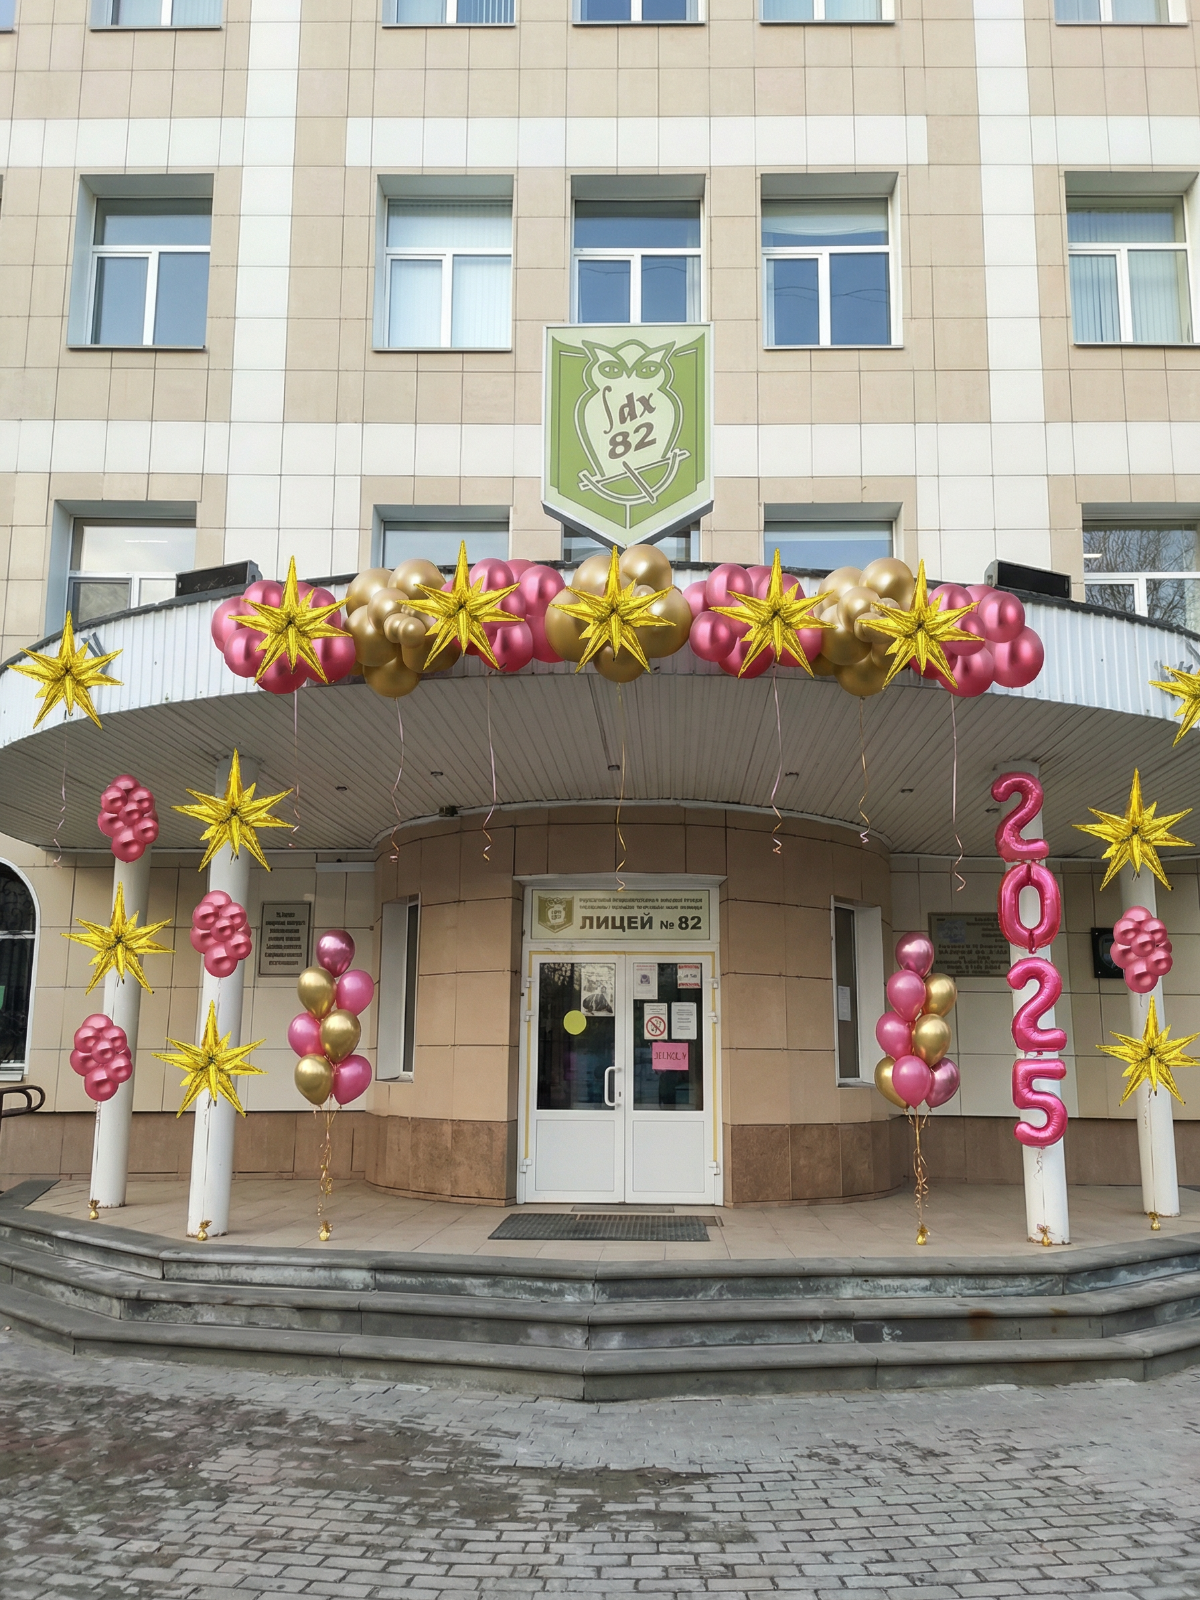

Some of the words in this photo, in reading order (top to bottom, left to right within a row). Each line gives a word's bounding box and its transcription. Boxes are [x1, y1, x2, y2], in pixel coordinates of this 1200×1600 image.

[608, 422, 657, 460] 82
[580, 912, 653, 932] ЛИЦЕЙ
[678, 915, 702, 930] 82
[991, 772, 1068, 1147] 2025
